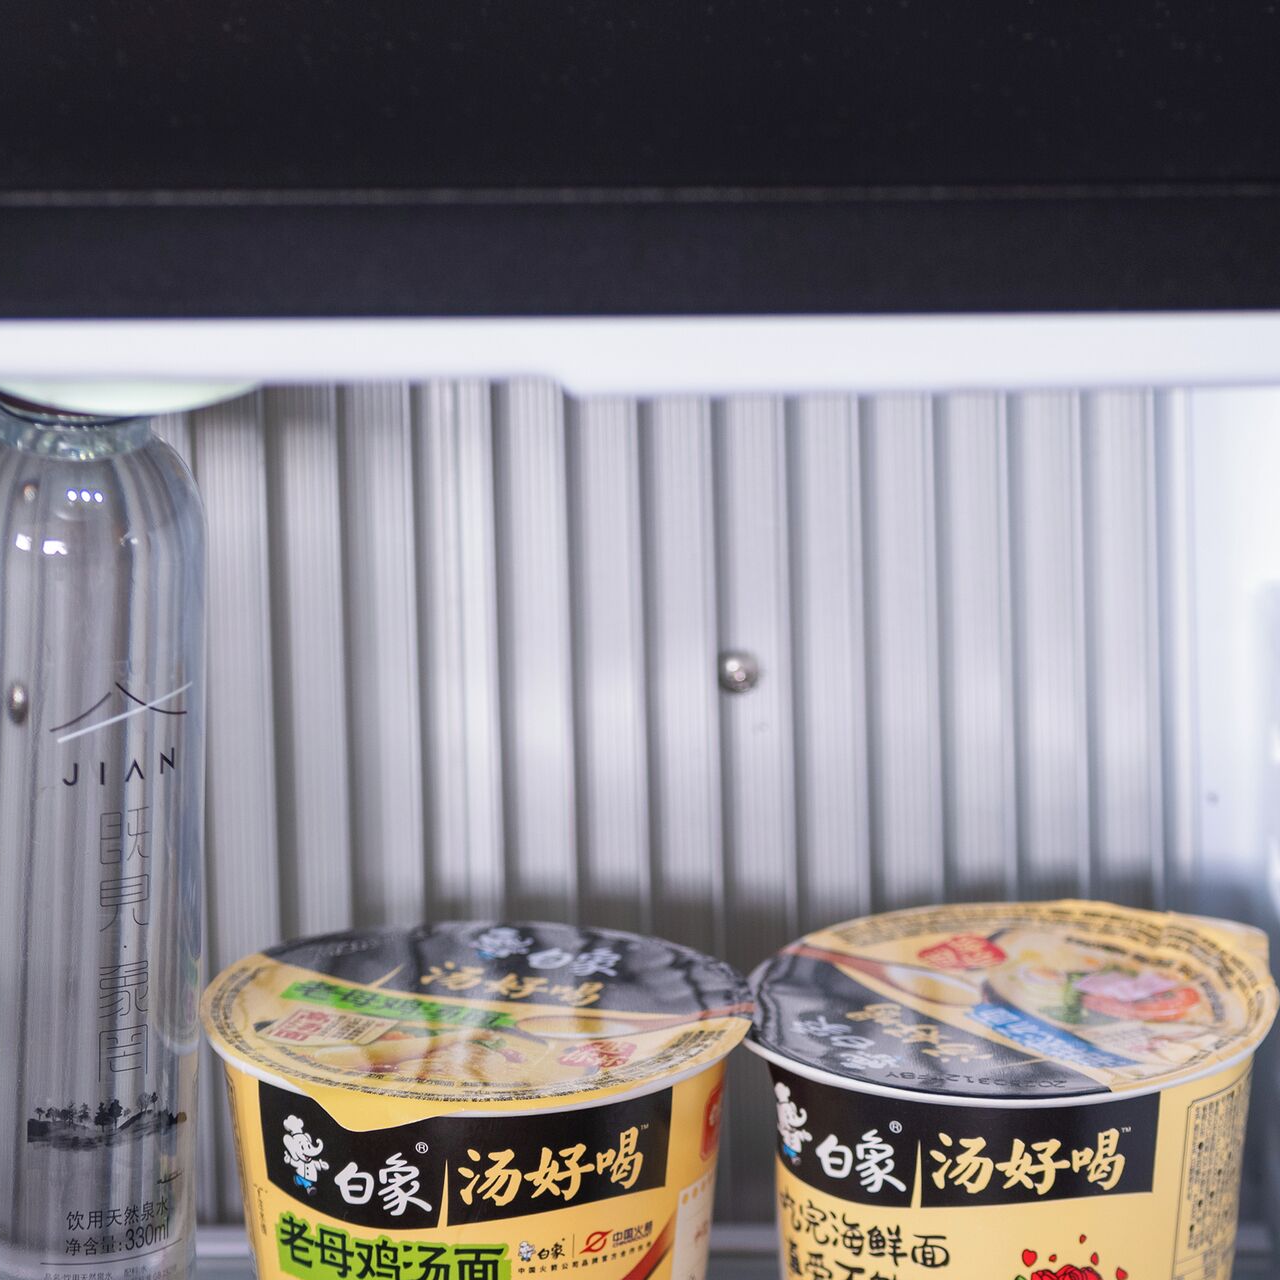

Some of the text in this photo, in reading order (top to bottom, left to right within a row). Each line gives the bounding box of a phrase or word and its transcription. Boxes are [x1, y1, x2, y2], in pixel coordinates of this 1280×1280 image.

[62, 747, 175, 786] JIAN
[334, 1151, 432, 1217] 白象
[457, 1124, 646, 1209] 汤好喝
[815, 1129, 908, 1194] 白象
[928, 1127, 1126, 1195] 汤好喝
[65, 1197, 169, 1231] 饮用天然泉水
